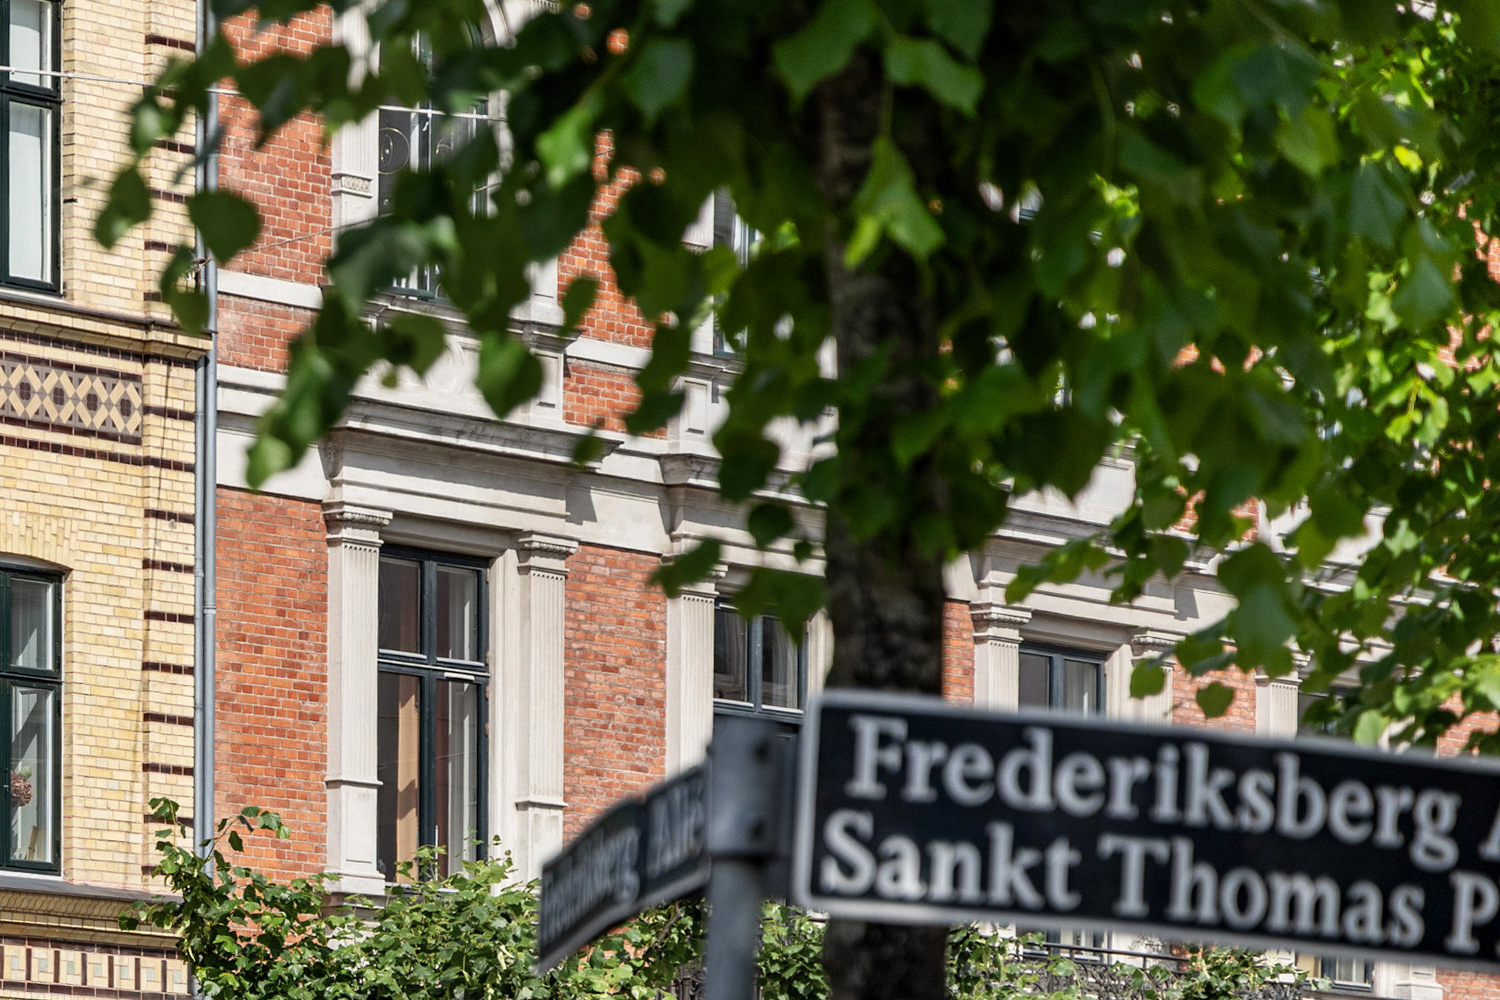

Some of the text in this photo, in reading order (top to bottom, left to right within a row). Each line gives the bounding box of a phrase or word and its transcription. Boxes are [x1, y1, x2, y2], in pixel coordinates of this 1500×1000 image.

[844, 714, 1461, 873] Frederiksberg
[819, 808, 1500, 954] Sankt Thomas P
